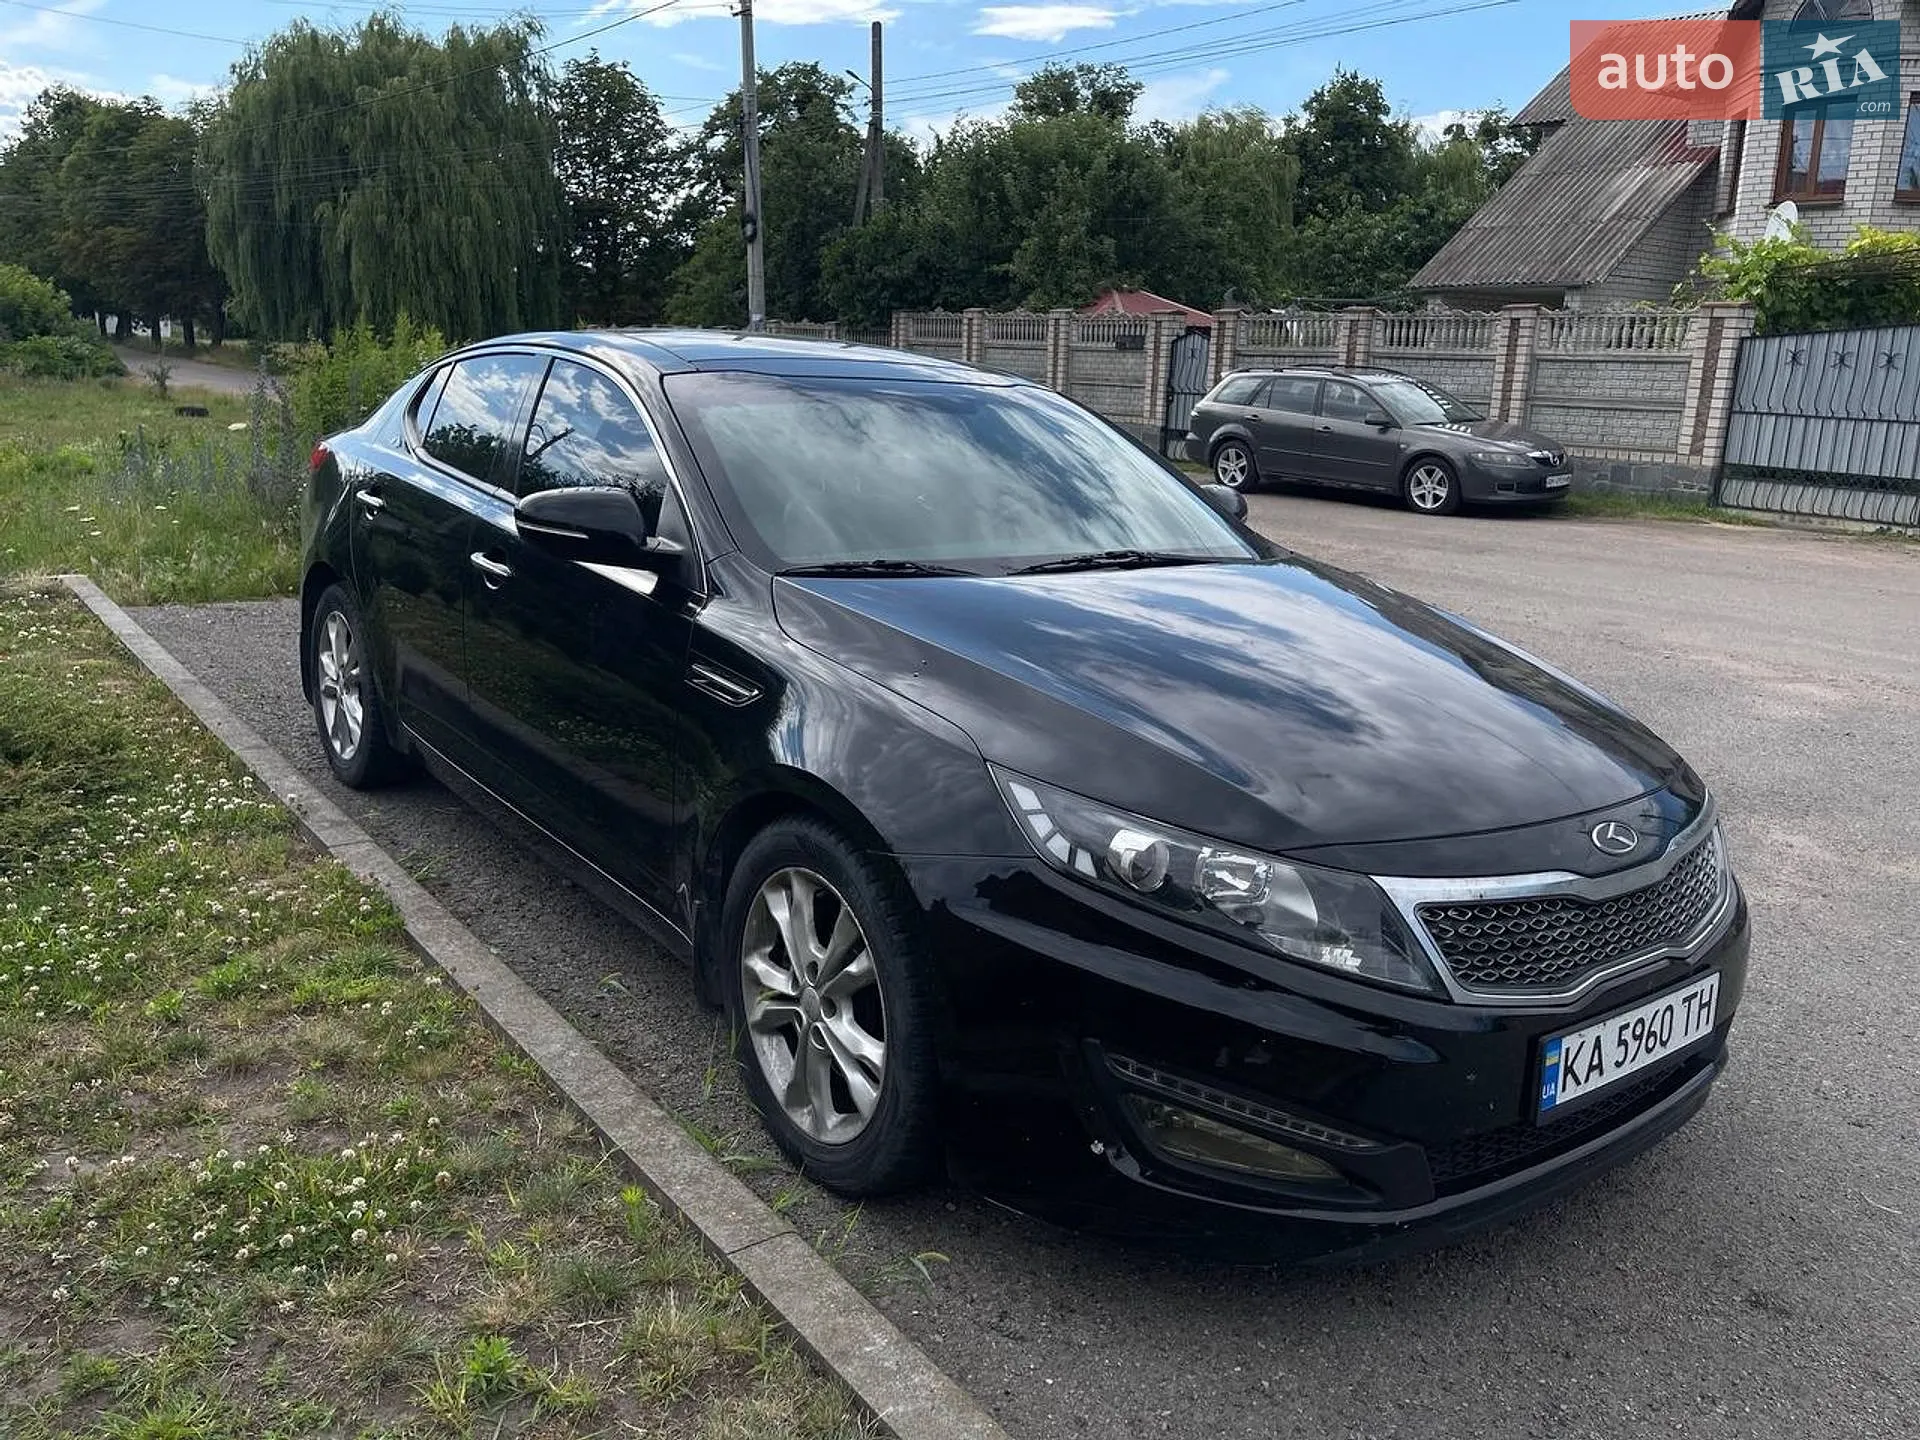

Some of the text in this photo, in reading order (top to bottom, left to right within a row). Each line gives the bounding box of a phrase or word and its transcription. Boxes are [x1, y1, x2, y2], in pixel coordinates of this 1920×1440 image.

[1561, 984, 1715, 1093] KA 5960 TH
[1542, 1082, 1556, 1099] UA
